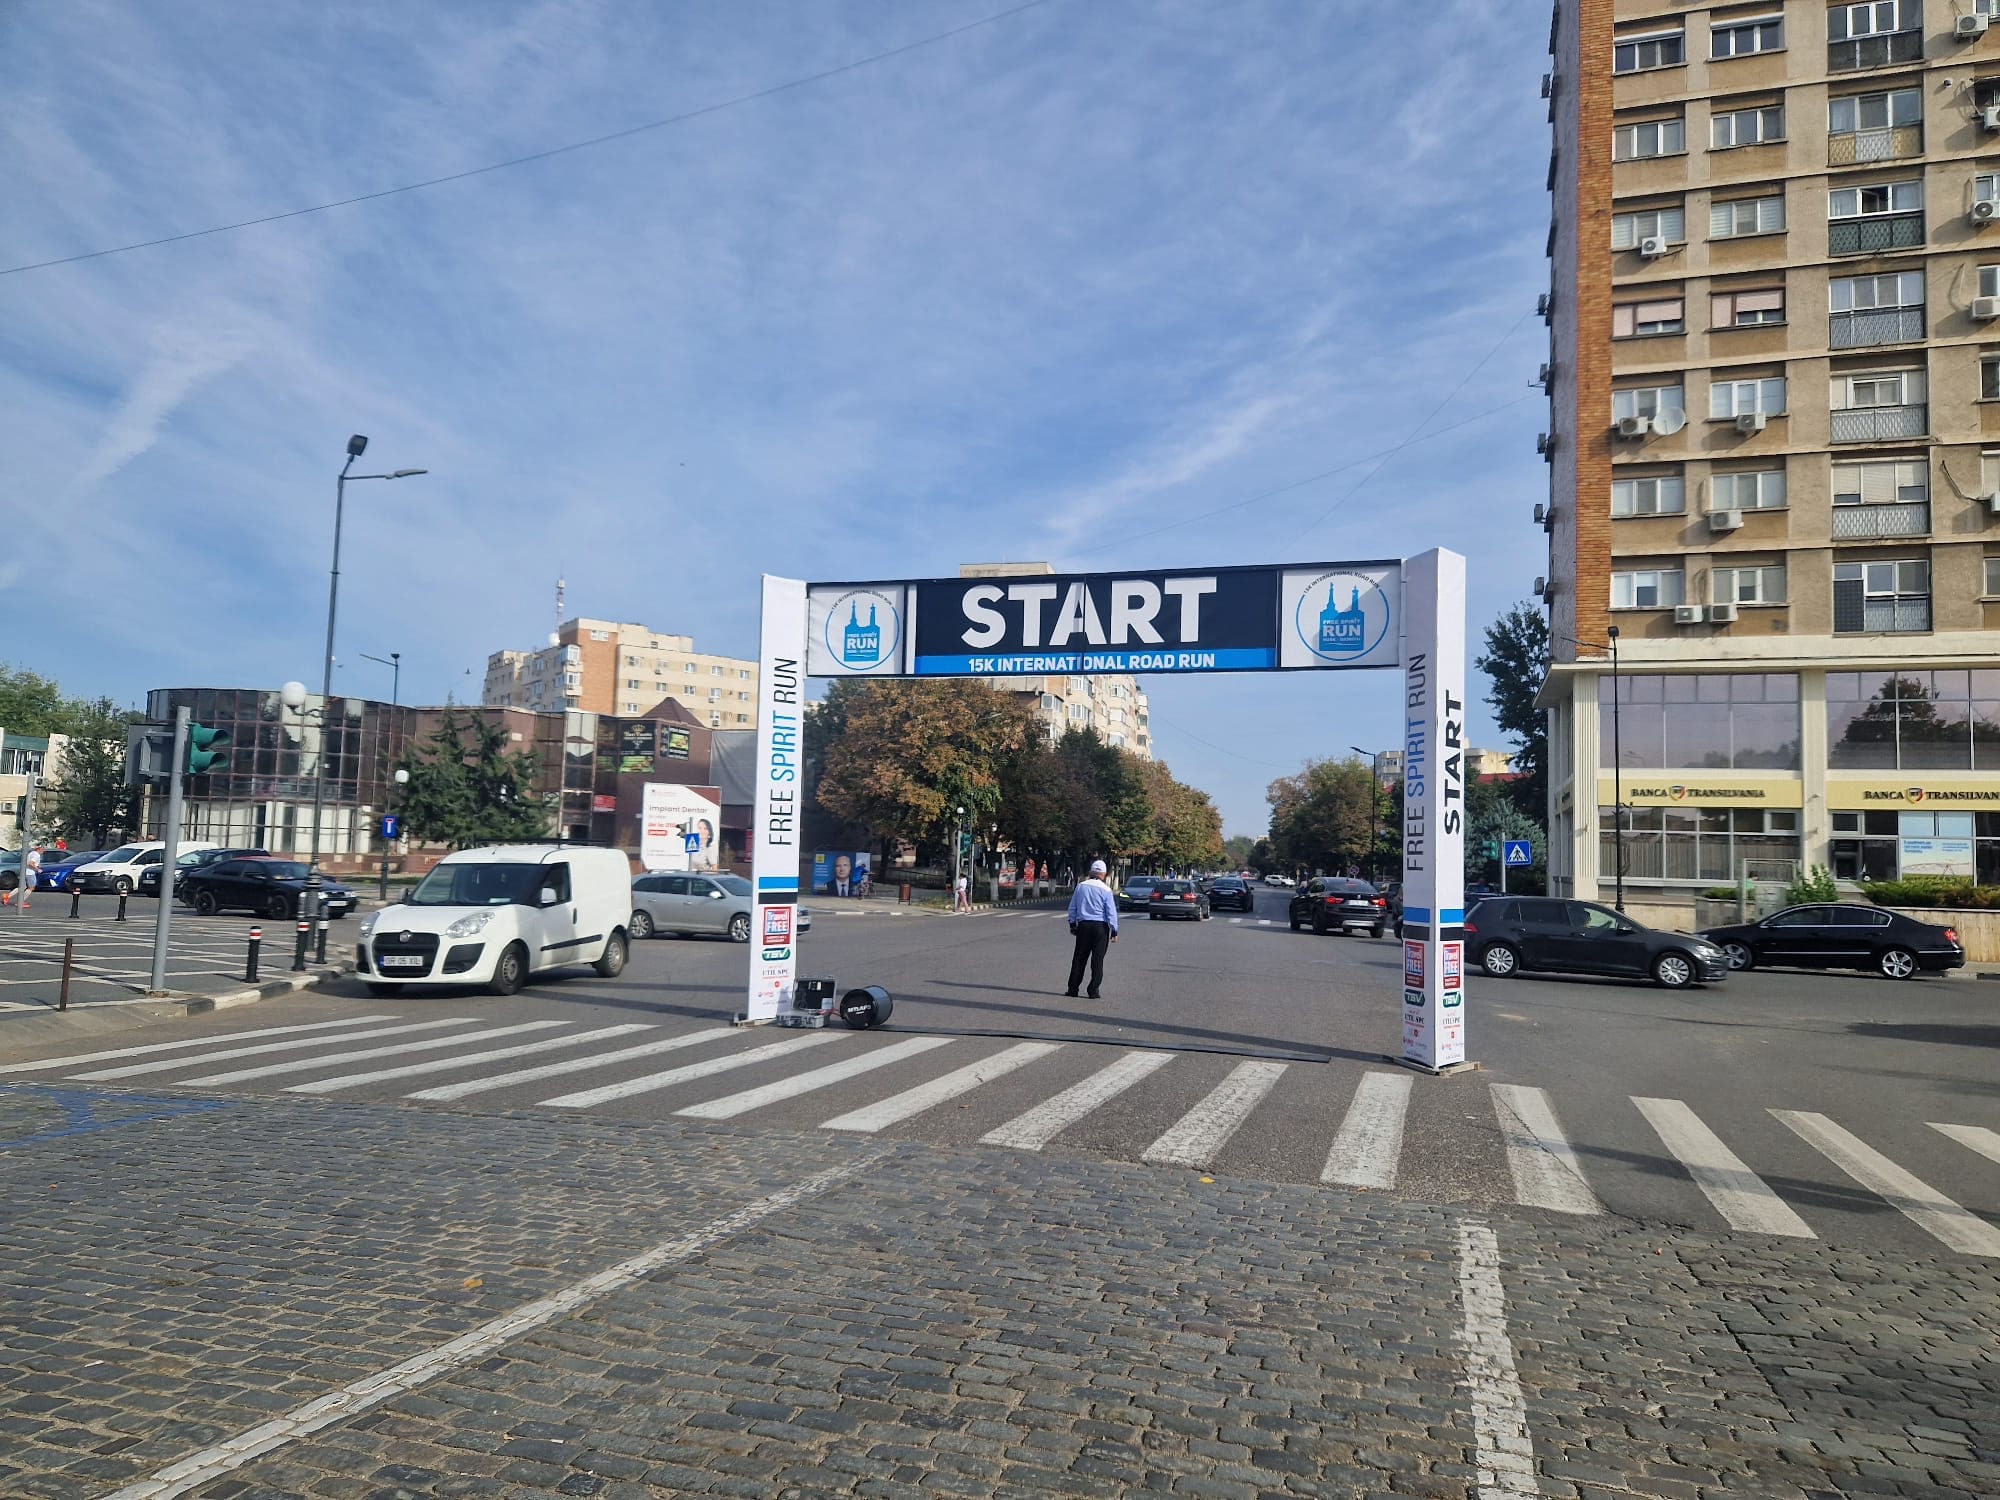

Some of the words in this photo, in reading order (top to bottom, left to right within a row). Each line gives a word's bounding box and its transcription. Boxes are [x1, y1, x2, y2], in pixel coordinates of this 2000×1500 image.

[961, 576, 1217, 649] START
[1323, 625, 1360, 637] RUN
[847, 638, 877, 649] RUN
[969, 658, 995, 672] 15K
[997, 655, 1126, 672] INTERNATIONAL
[1128, 654, 1175, 669] ROAD
[1178, 653, 1216, 668] RUN
[773, 657, 798, 705] RUN
[1408, 652, 1427, 709] RUN
[770, 710, 797, 782] SPIRIT
[1407, 716, 1426, 798] SPIRIT
[1444, 689, 1462, 836] START
[1631, 788, 1668, 797] BANCA
[1687, 789, 1766, 798] TRANSILVANIA
[1864, 790, 1905, 800] BANCA
[649, 804, 680, 814] Implant
[681, 806, 708, 814] Dentar
[768, 789, 794, 846] FREE
[1406, 805, 1425, 873] FREE
[767, 911, 788, 921] Travel
[767, 920, 789, 932] FREE
[1407, 947, 1423, 960] Travel
[1444, 949, 1459, 961] Travel
[1406, 959, 1423, 975] FREE
[1444, 960, 1459, 974] FREE
